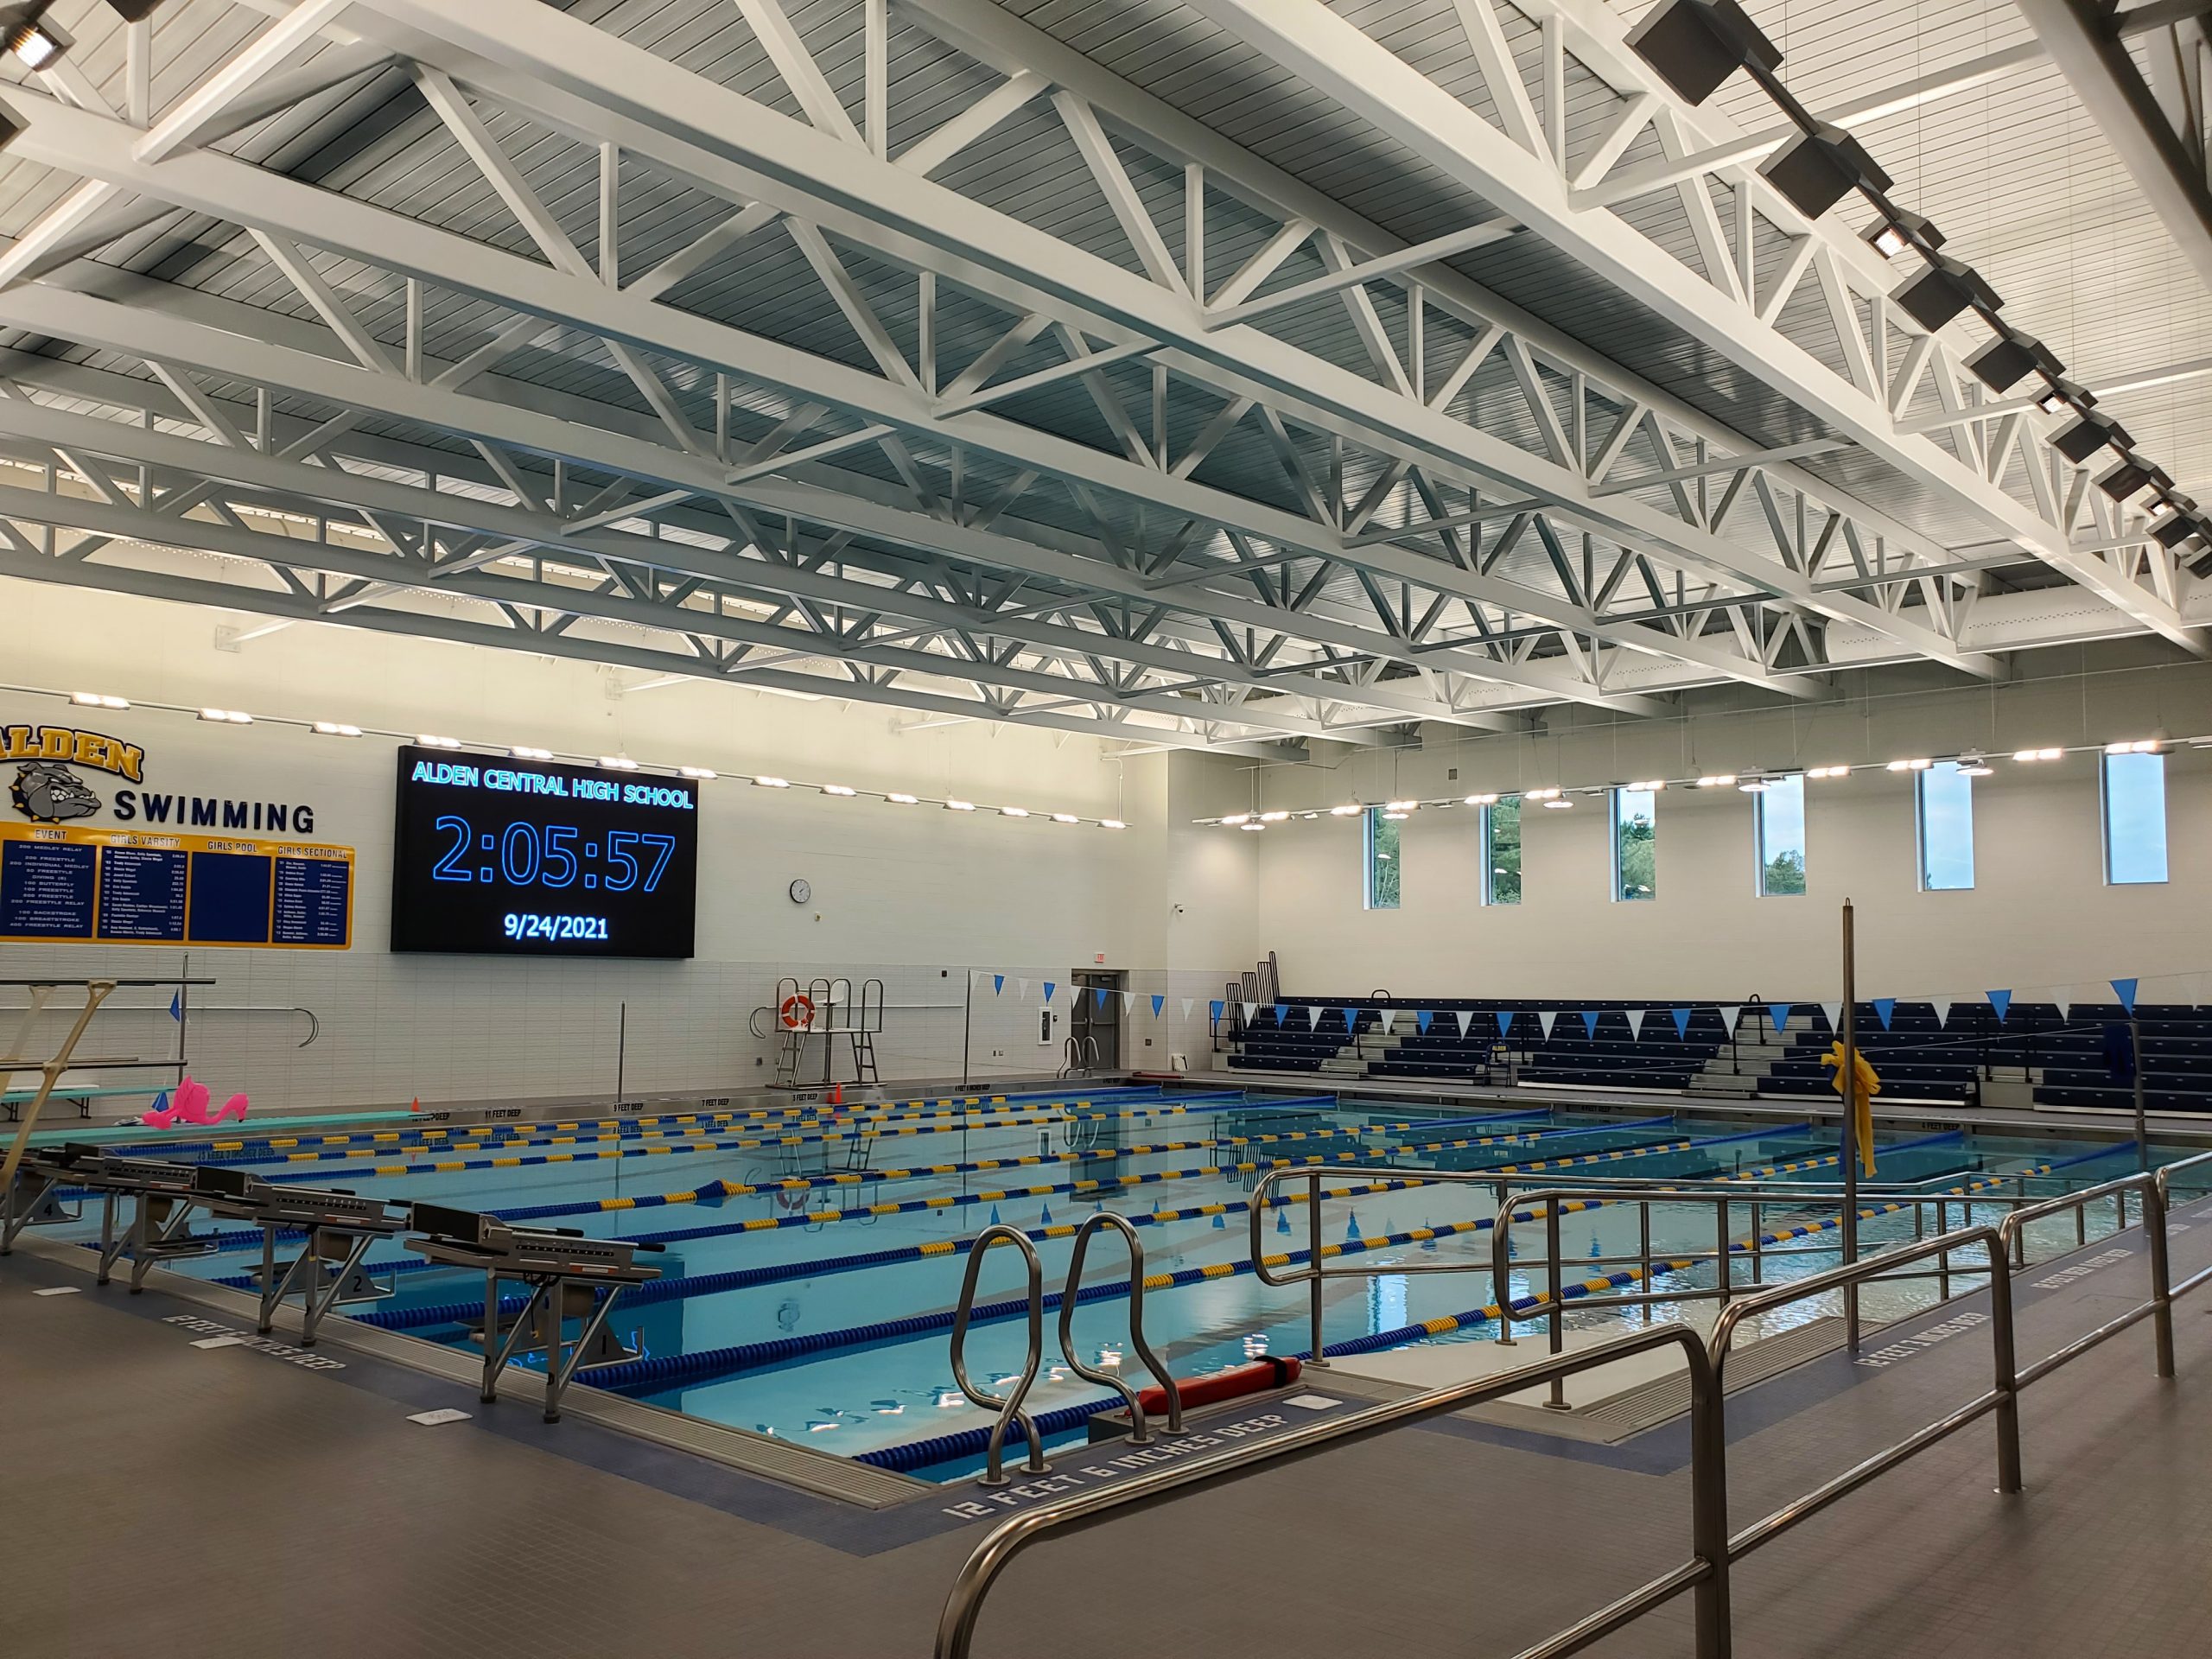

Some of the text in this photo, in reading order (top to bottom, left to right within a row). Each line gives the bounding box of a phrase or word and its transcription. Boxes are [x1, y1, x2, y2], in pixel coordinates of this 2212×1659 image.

[412, 760, 694, 809] ALDEN CENTRAL HIGH SCHOOL
[113, 791, 315, 833] SWIMMING
[35, 830, 67, 840] EVENT
[111, 834, 180, 847] GIRLS VARSITY
[207, 841, 257, 853] GIRLS POOL
[277, 846, 347, 859] GIRLS SECTIONAL
[433, 816, 676, 892] 2:05:57
[504, 913, 608, 941] 9/24/2021
[619, 1103, 631, 1111] FEET
[631, 1103, 644, 1111] DEEP
[706, 1098, 717, 1107] FEET
[717, 1097, 729, 1106] DEEP
[435, 1112, 450, 1121] DEEP
[485, 1109, 522, 1119] 11 FEET DEEP
[43, 1203, 53, 1217] 4
[353, 1275, 362, 1293] 2
[177, 1317, 235, 1334] FEET
[283, 1352, 347, 1370] DEEP
[601, 1334, 607, 1356] 1
[1867, 1344, 1921, 1361] FEET
[1908, 1323, 1969, 1342] INCHES
[941, 1414, 1288, 1519] 12 FEET 6 INCHES DEEP
